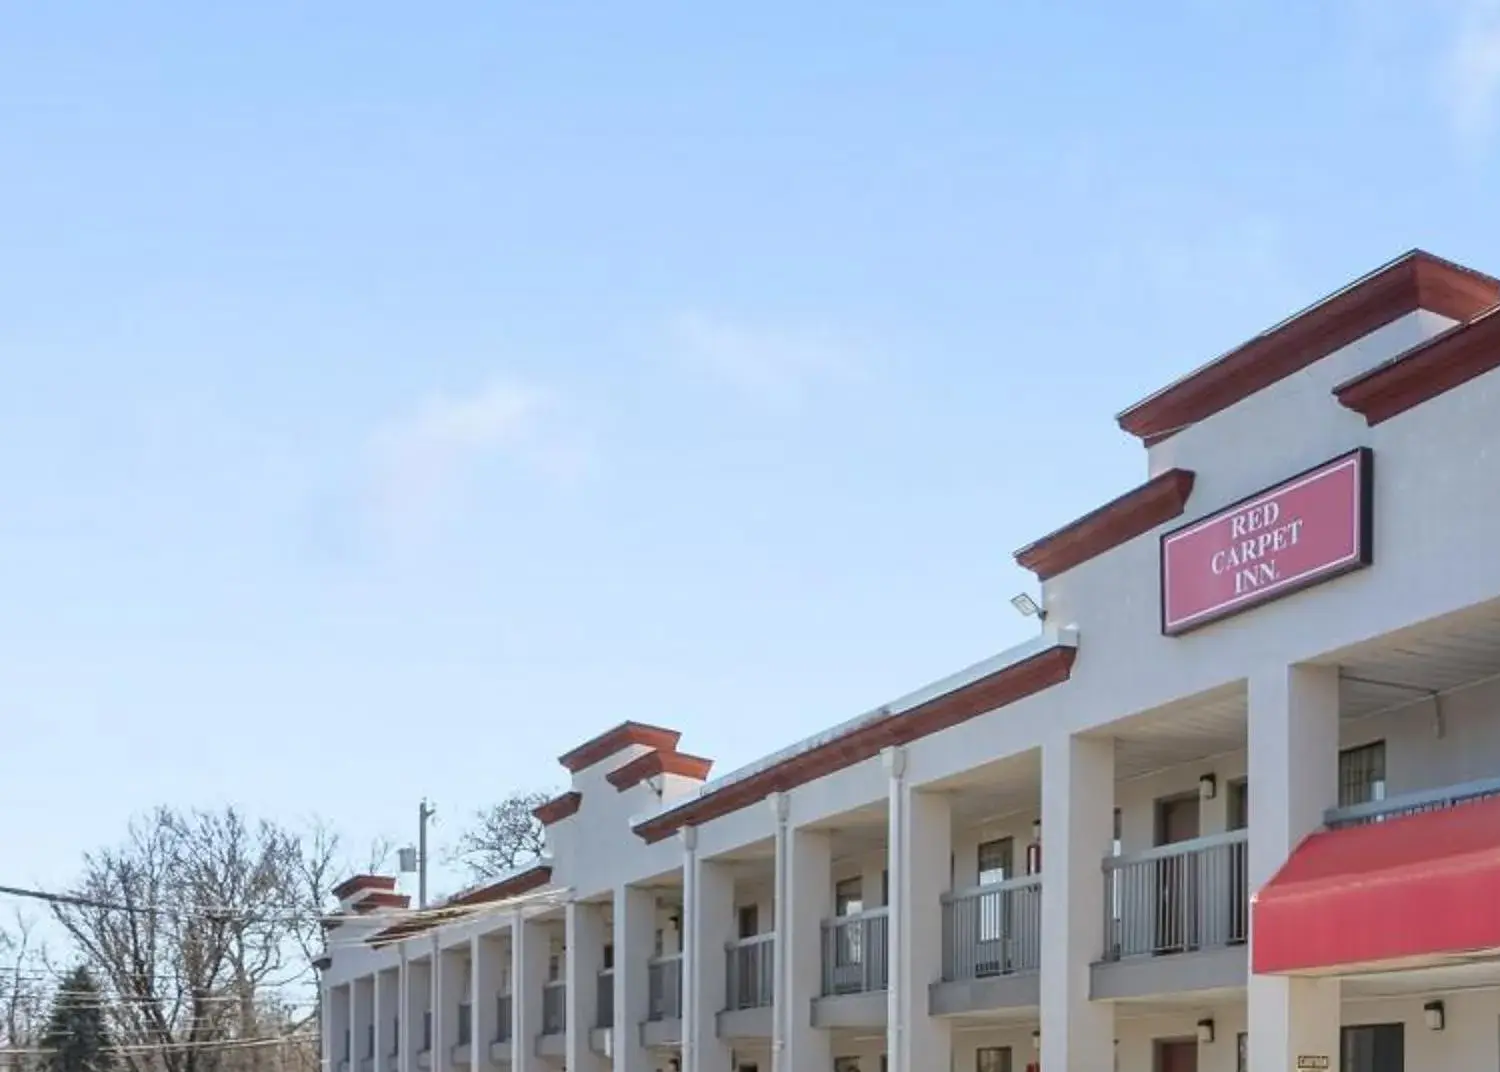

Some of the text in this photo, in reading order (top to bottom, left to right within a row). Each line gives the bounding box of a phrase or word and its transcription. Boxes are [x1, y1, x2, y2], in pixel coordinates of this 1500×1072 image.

[1232, 502, 1279, 538] RED
[1212, 519, 1303, 574] CARPET
[1235, 560, 1276, 593] INN
